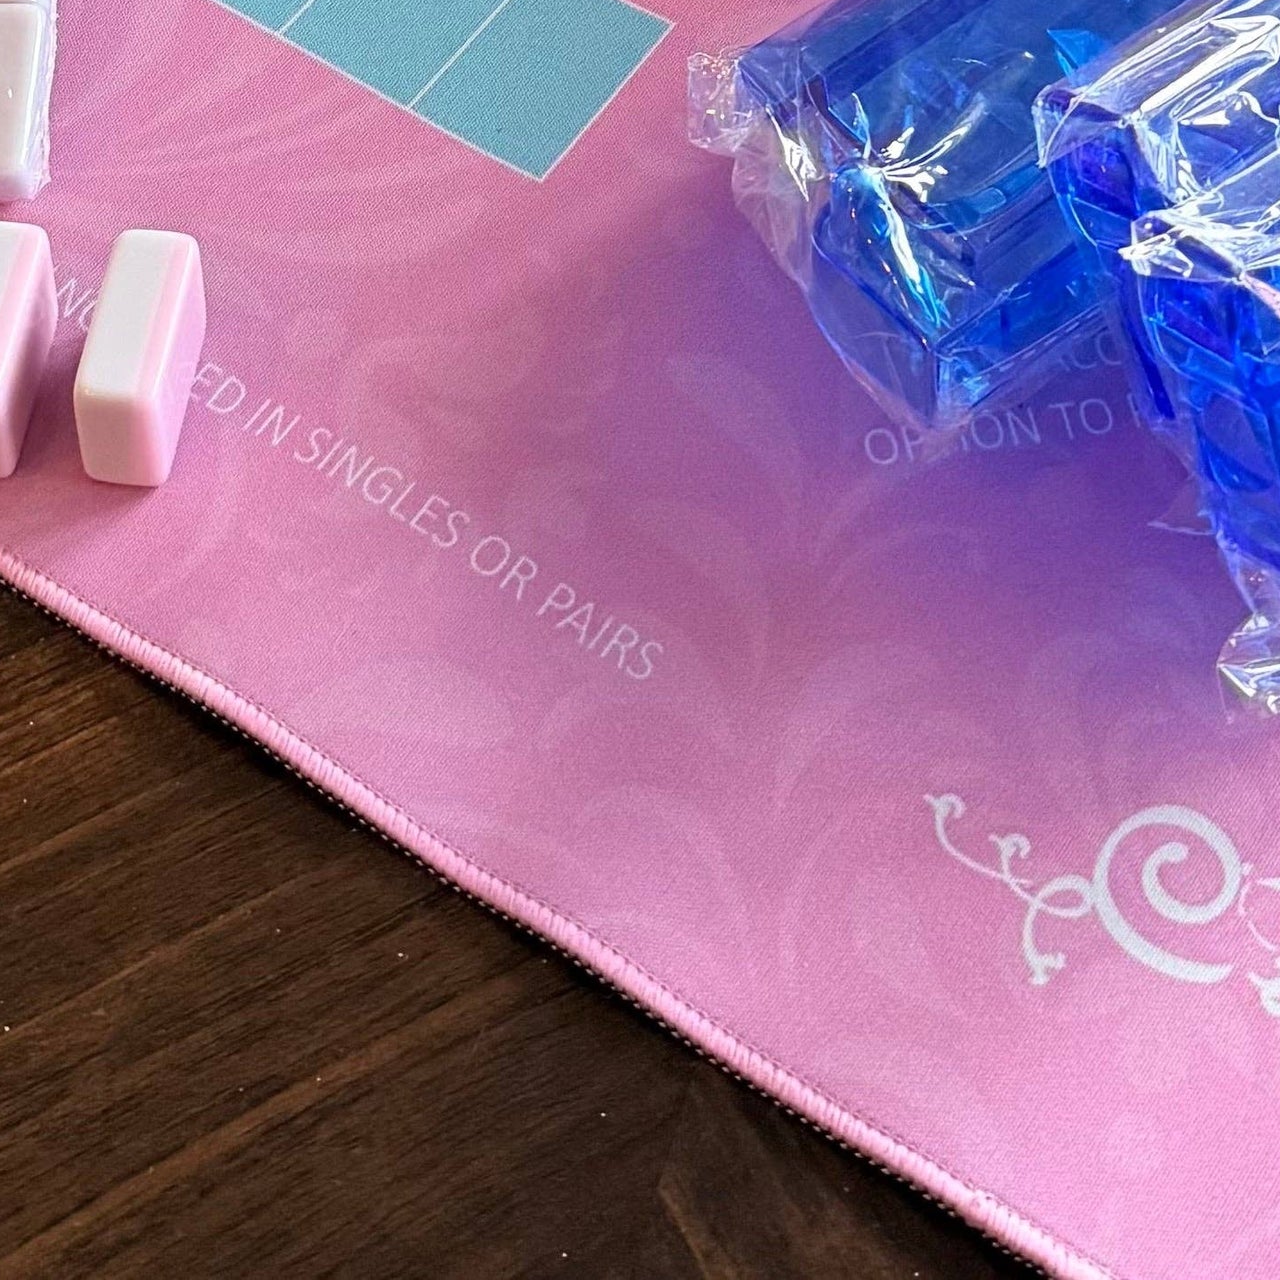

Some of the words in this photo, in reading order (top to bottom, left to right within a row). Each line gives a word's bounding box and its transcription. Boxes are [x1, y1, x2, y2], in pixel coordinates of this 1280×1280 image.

[1049, 398, 1113, 441] TO
[243, 398, 301, 447] IN
[293, 427, 471, 549] SINGLES
[468, 536, 537, 600] OR
[536, 582, 663, 680] PAIRS
